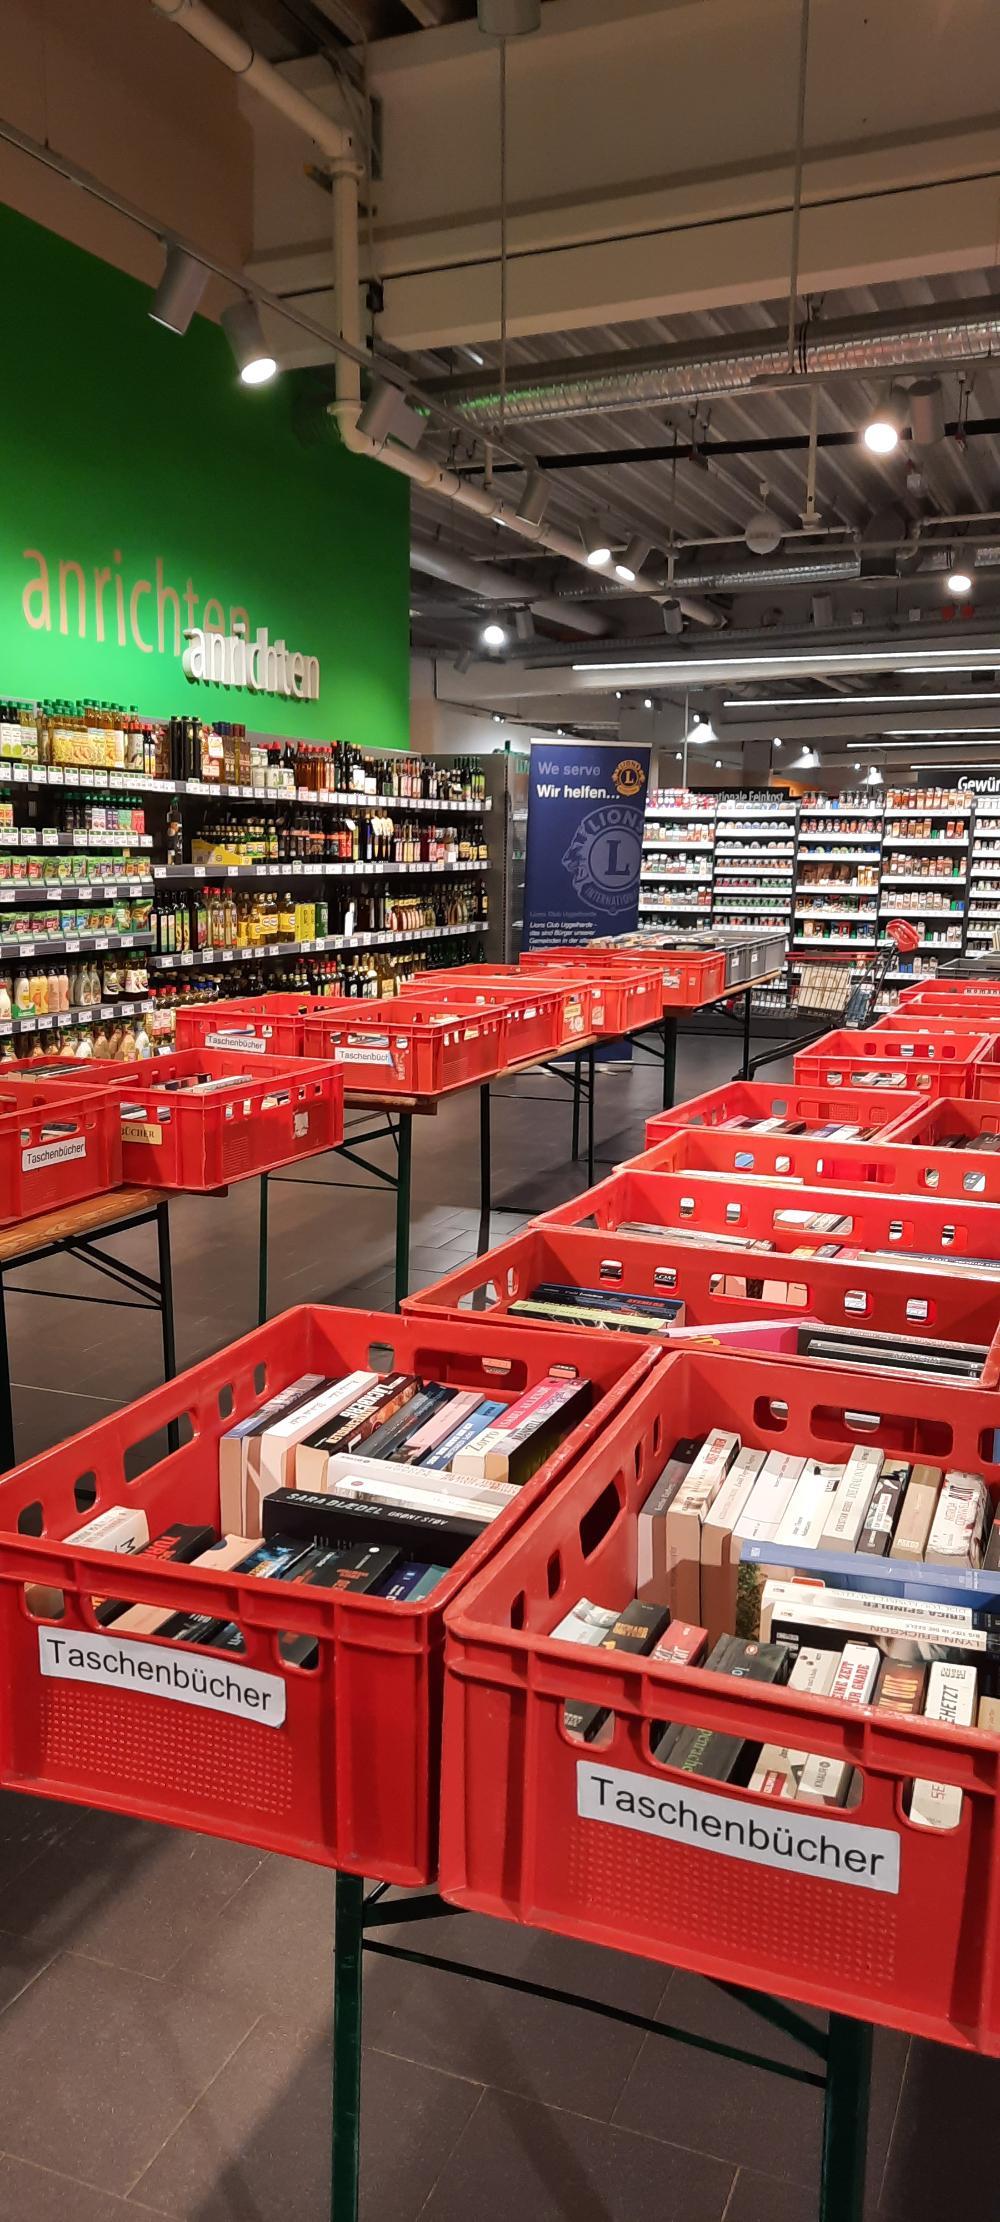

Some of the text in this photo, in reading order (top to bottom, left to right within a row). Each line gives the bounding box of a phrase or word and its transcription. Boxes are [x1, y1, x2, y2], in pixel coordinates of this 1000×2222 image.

[181, 622, 321, 701] anrichten
[538, 762, 600, 775] We serve
[537, 784, 620, 799] Wir helfen...
[957, 776, 1000, 794] Gewür
[587, 809, 644, 834] LIONS
[605, 839, 630, 876] L
[208, 1035, 263, 1050] Taschenbücher
[339, 1051, 389, 1062] Taschenbüch
[27, 1143, 85, 1165] Taschenbücher
[464, 1428, 499, 1452] Zorro
[285, 1491, 323, 1505] SARA
[324, 1498, 384, 1516] BLÆDEL
[861, 1600, 965, 1621] ERICA SPINDLER
[868, 1624, 980, 1647] LYNN ERICKSON
[46, 1638, 272, 1711] Taschenbücher
[831, 1659, 853, 1699] EINE ZEIT
[851, 1662, 870, 1690] GNADE
[881, 1673, 919, 1700] OUT
[938, 1683, 958, 1723] EHETZT
[589, 1775, 885, 1877] Taschenbücher
